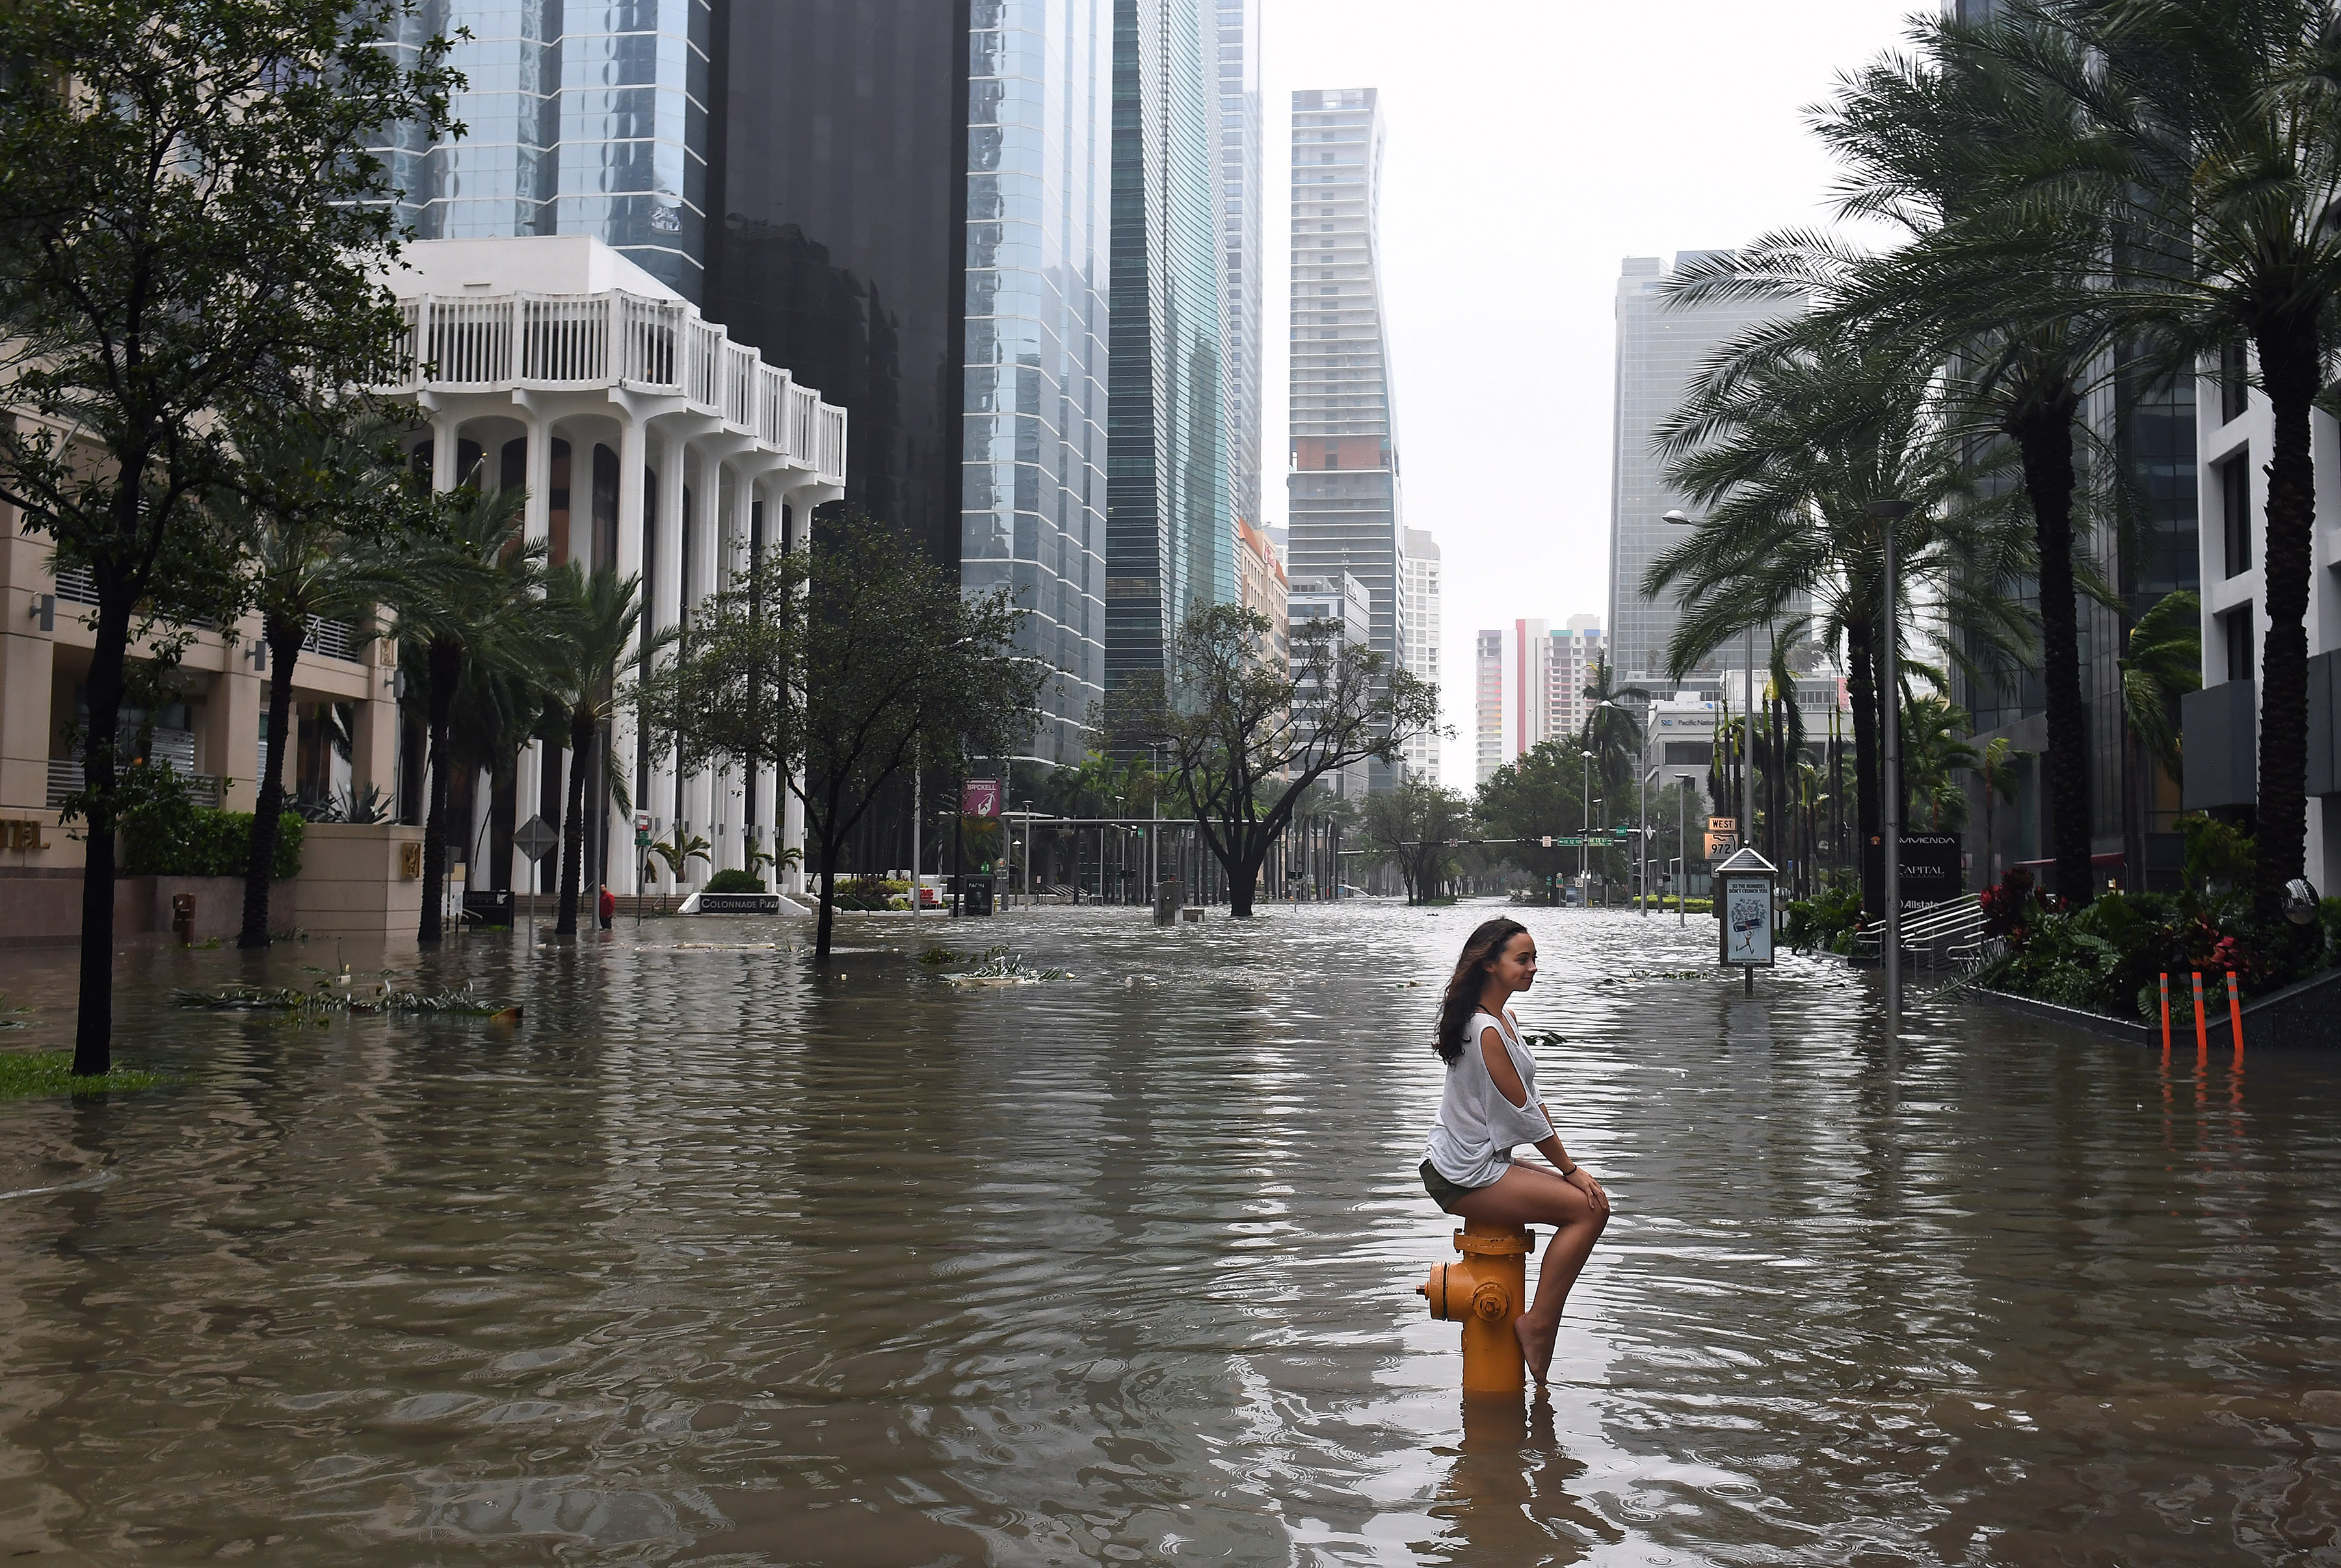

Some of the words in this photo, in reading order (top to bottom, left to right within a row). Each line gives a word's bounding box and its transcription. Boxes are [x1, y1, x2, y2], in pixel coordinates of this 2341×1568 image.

[1712, 820, 1732, 828] WEST
[1712, 844, 1730, 854] 972
[1904, 900, 1939, 909] Allstate
